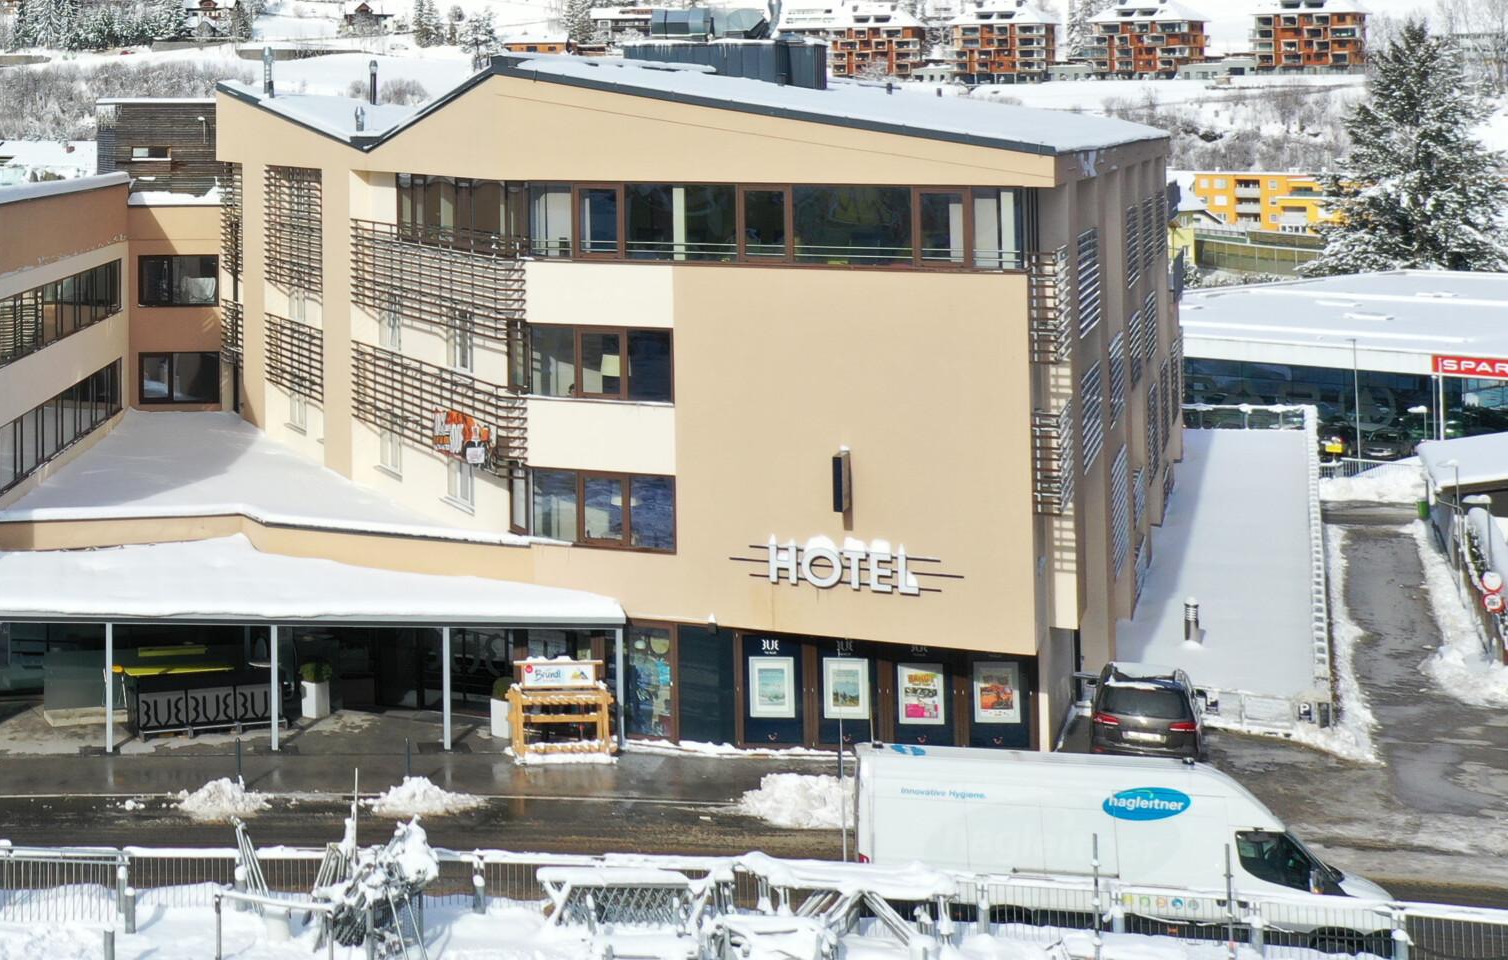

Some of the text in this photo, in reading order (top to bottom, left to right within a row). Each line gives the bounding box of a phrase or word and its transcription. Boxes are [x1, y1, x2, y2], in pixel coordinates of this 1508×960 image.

[1442, 359, 1508, 373] SPAR
[768, 542, 920, 594] HOTEL
[1300, 703, 1310, 714] P
[1108, 796, 1184, 811] hagleitner
